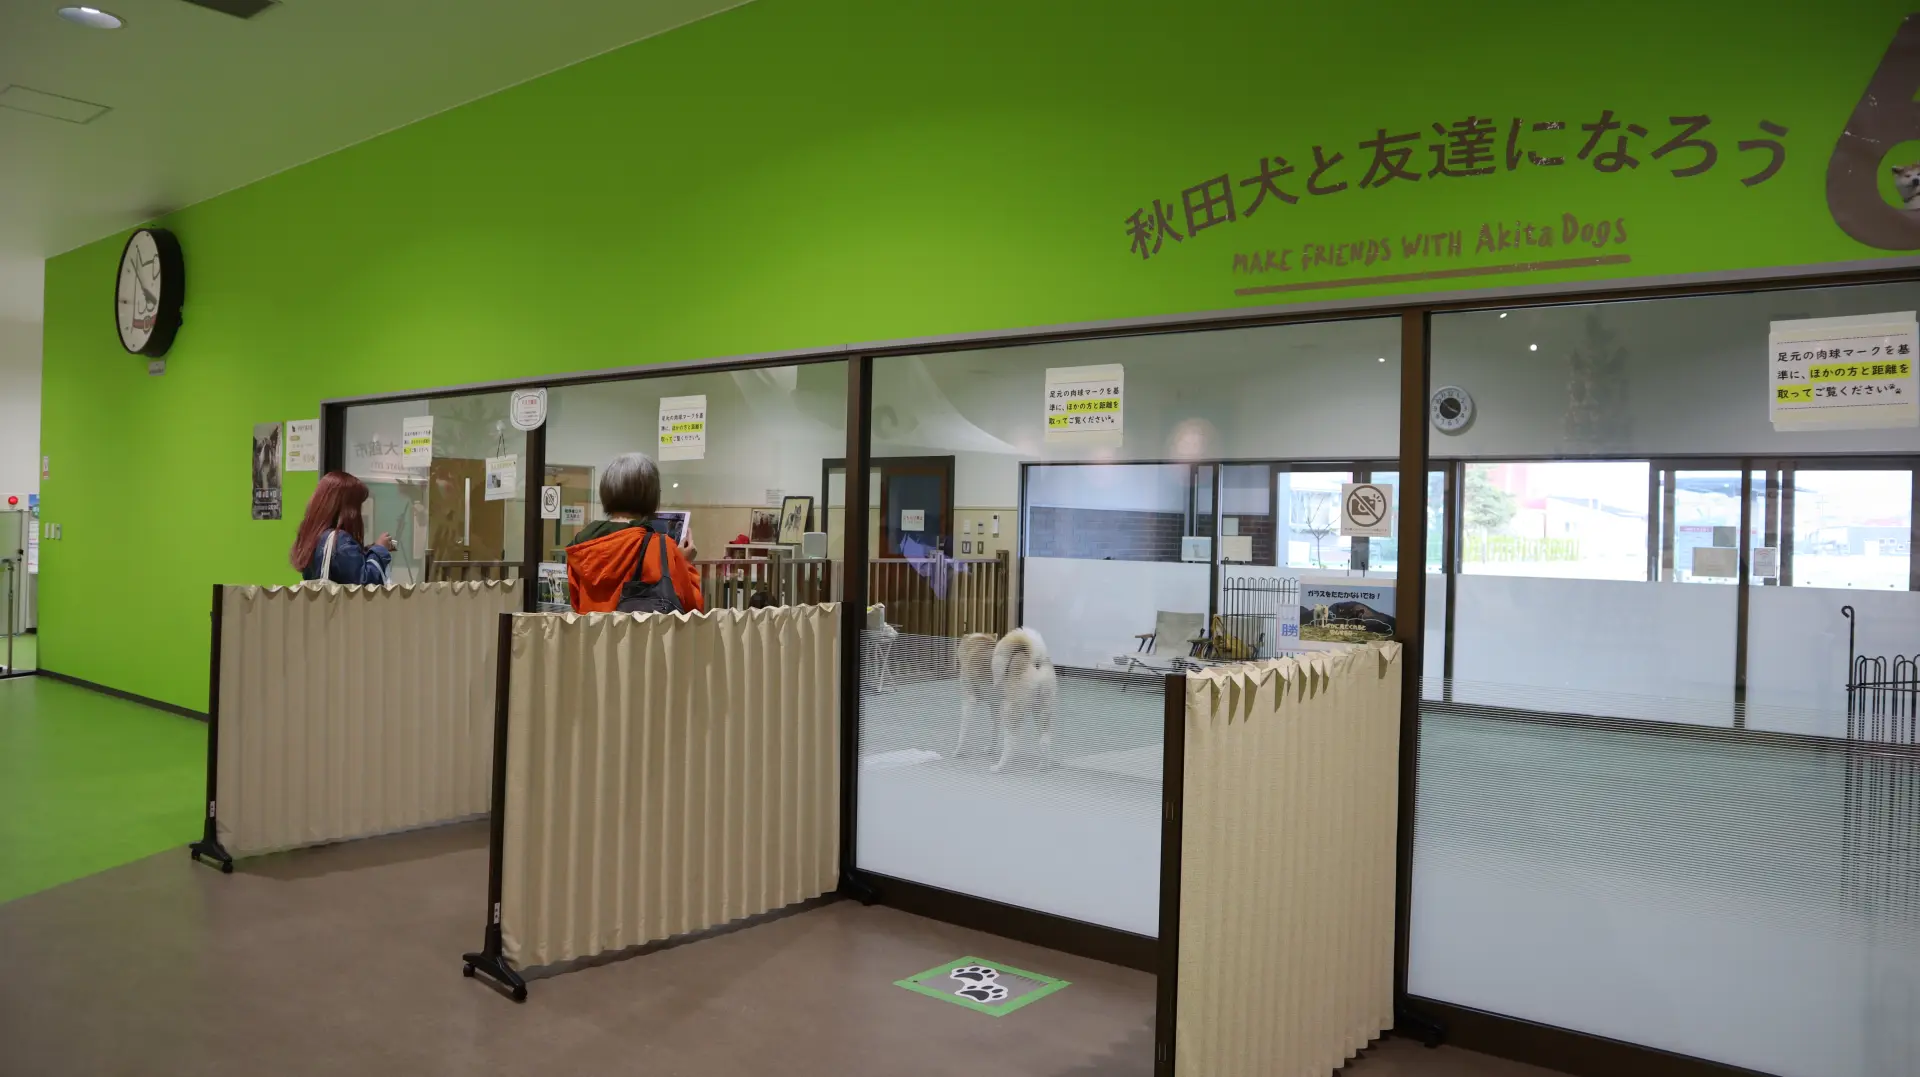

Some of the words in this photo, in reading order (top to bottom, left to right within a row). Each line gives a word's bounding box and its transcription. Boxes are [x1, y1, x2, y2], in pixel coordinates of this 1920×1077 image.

[1124, 110, 1789, 260] 秋田犬と友達になろう
[1232, 249, 1294, 273] MAKE
[1303, 237, 1391, 271] FRIENDS
[1401, 230, 1462, 259] WITH
[1475, 220, 1555, 255] Akita
[1562, 212, 1627, 248] Dogs
[1777, 344, 1910, 361] 足元の肉球マークを基
[1777, 364, 1909, 381] 準に、ほかの方と距離を
[1049, 387, 1119, 398] 足元の肉球マークを基
[1777, 385, 1888, 399] 取ってご覧ください
[1049, 401, 1119, 411] 準に、ほかの方と距離を
[1281, 623, 1298, 637] 勝
